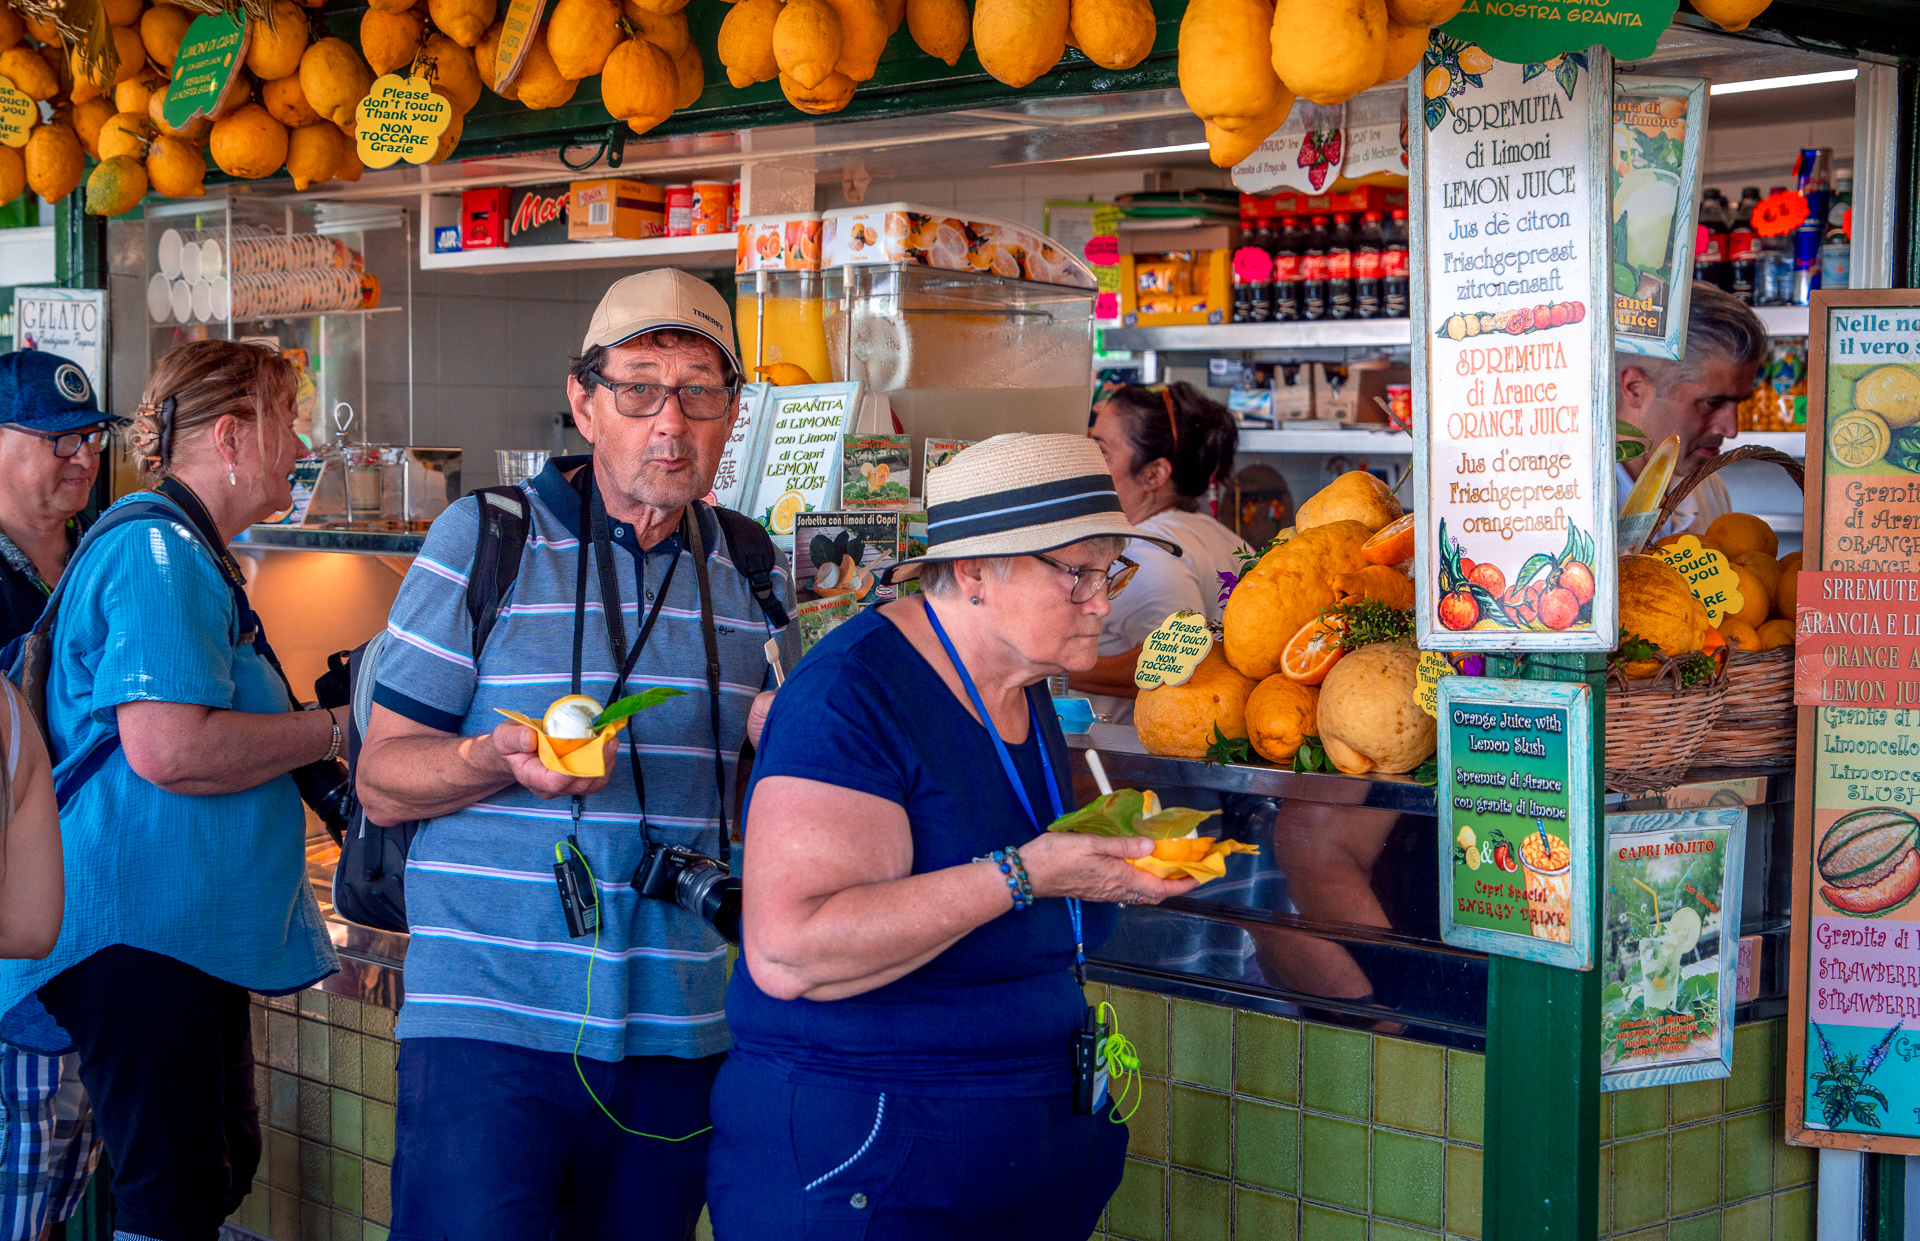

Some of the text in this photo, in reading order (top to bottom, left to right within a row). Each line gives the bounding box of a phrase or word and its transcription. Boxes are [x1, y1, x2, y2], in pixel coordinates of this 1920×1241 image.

[1485, 2, 1643, 27] NOSTRA GRANITA
[216, 32, 240, 49] CAPRI
[382, 88, 429, 100] Please
[2, 105, 26, 116] you
[363, 97, 444, 112] don't touch
[1452, 93, 1564, 134] SPREMUTA
[1645, 101, 1661, 114] di
[365, 108, 438, 123] Thank you
[1624, 112, 1679, 127] Limone
[360, 131, 429, 145] TOCCARE
[380, 123, 412, 134] NON
[370, 142, 414, 154] Grazie
[1465, 133, 1551, 169] di Limoni
[1443, 165, 1576, 209] LEMON JUICE
[511, 191, 570, 236] Mar
[1449, 219, 1479, 240] Jus
[1516, 211, 1570, 232] citron
[1443, 239, 1577, 276] Frischgepresst
[1456, 267, 1564, 301] zitronensaft
[1617, 296, 1653, 312] and
[22, 301, 97, 332] GELATO
[1614, 309, 1658, 328] Juice
[1835, 314, 1890, 332] Nelle
[1840, 337, 1910, 355] il vero
[1456, 341, 1568, 376] SPREMUTA
[1466, 377, 1558, 407] di Arance
[782, 399, 843, 414] GRANITA
[775, 415, 842, 429] di LIMONE
[1447, 404, 1580, 440] ORANGE JUICE
[774, 432, 837, 445] con Limoni
[779, 448, 825, 461] di Capri
[1456, 449, 1572, 479] Jus d'orange
[765, 461, 818, 477] LEMON
[1449, 478, 1582, 511] Frischgepresst
[797, 513, 897, 527] Sorbetto con limoni di Capri
[1462, 506, 1569, 541] orangensaft
[1844, 508, 1864, 529] di
[1837, 535, 1920, 557] ORANGE
[1688, 565, 1719, 585] you
[1703, 590, 1728, 608] RE
[1823, 578, 1919, 602] SPREMUTE
[820, 598, 851, 611] MOJITO
[1707, 609, 1718, 619] e
[1168, 620, 1203, 634] Please
[1801, 612, 1882, 636] ARANCIA
[1887, 613, 1898, 636] E
[1151, 629, 1208, 646] don't touch
[1149, 640, 1200, 656] Thank you
[1823, 644, 1900, 669] ORANGE
[1141, 660, 1184, 674] TOCCARE
[1156, 654, 1177, 664] NON
[1426, 655, 1447, 668] Please
[1136, 670, 1161, 683] Grazie
[1418, 664, 1435, 675] don't
[1822, 679, 1887, 702] LEMON
[1453, 709, 1563, 733] Orange Juice with
[1823, 706, 1911, 729] Granita di
[1469, 734, 1546, 757] Lemon Slush
[1824, 734, 1920, 756] Limoncello
[1456, 767, 1562, 792] Spremuta di Arance
[1454, 796, 1567, 819] con granita di limone
[1480, 840, 1494, 864] &
[1618, 840, 1715, 860] CAPRI MOJITO
[1475, 879, 1548, 904] Capri Special
[1684, 882, 1720, 914] no alcool
[1458, 897, 1567, 927] ENERGY DRINK
[1817, 923, 1909, 950] Granita di
[1616, 1023, 1698, 1039] scorzette di limone
[1620, 1014, 1695, 1029] Granita di limone
[1624, 1033, 1688, 1048] foglie di menta
[1632, 1046, 1658, 1056] acqua
[1660, 1043, 1687, 1052] tonica
